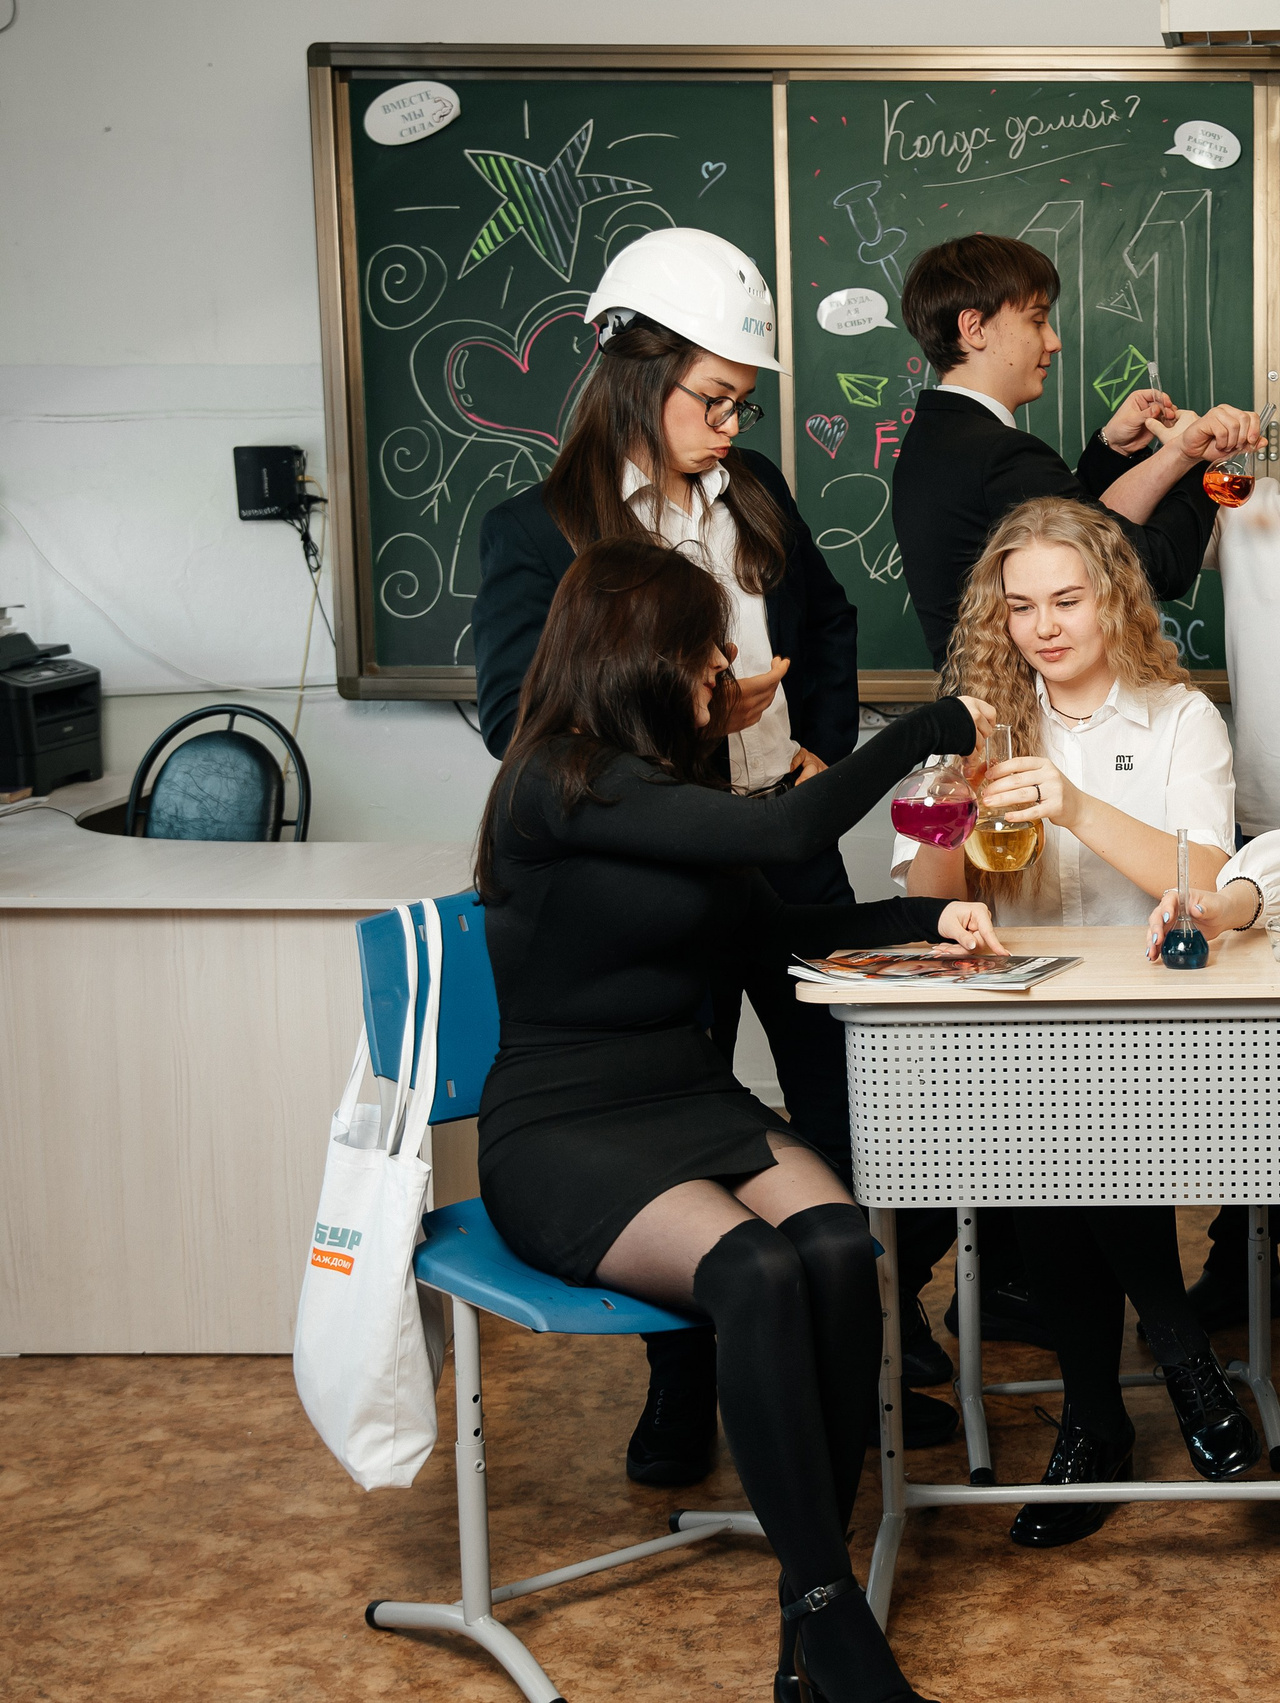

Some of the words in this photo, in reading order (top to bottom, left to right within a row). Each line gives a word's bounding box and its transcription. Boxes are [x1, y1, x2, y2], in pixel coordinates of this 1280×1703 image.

[381, 89, 433, 114] ВМЕСТЕ
[401, 109, 424, 123] МЫ
[400, 121, 434, 137] СИЛА
[884, 99, 996, 173] Когда
[1006, 96, 1140, 159] домой?
[742, 316, 765, 337] АГХК
[844, 318, 873, 328] СИБУР
[1116, 755, 1134, 763] MT
[1116, 763, 1134, 771] BW
